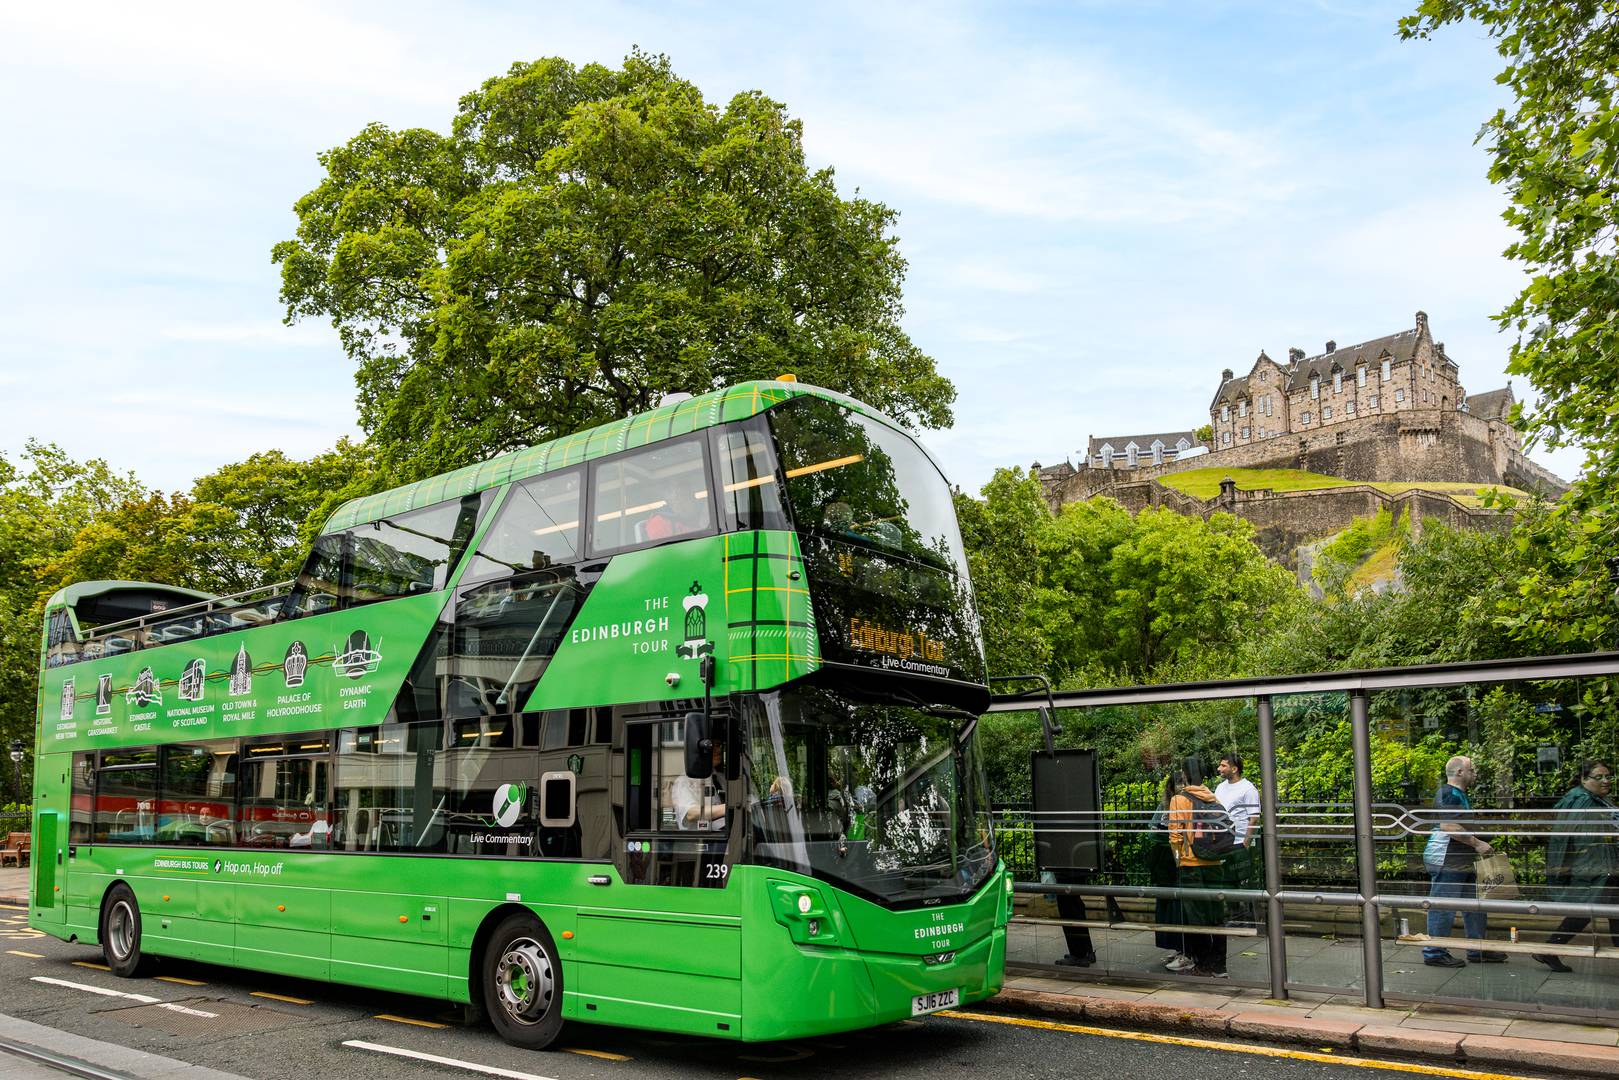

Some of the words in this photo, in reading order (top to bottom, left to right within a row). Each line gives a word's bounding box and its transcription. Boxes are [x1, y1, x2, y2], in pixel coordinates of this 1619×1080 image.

[645, 597, 669, 611] THE
[572, 617, 669, 643] EDINBURGH
[633, 640, 668, 654] TOUR
[882, 656, 899, 667] Live
[901, 659, 950, 677] Commentary
[339, 685, 372, 697] DYNAMIC
[277, 694, 301, 704] PALACE
[302, 693, 311, 701] OF
[343, 699, 367, 709] EARTH
[167, 708, 192, 717] NATIONAL
[192, 705, 215, 714] MUSEUM
[222, 702, 234, 711] OLD
[234, 700, 252, 709] TOWN
[252, 700, 257, 708] &
[266, 704, 323, 718] HOLYROODHOUSE
[129, 712, 157, 722] EDINBURGH
[172, 720, 180, 728] OF
[181, 717, 208, 726] SCOTLAND
[222, 714, 241, 722] ROYAL
[242, 711, 256, 720] MILE
[470, 834, 484, 843] Live
[485, 834, 533, 846] Commentary
[154, 859, 181, 868] EDINBURGH
[181, 860, 192, 869] BUS
[192, 861, 209, 870] TOURS
[224, 861, 239, 874] Hop
[240, 864, 252, 875] on,
[253, 862, 271, 876] Hop
[272, 863, 284, 875] off
[706, 863, 729, 879] 239
[931, 912, 945, 921] THE
[914, 922, 964, 939] EDINBURGH
[931, 939, 950, 949] TOUR
[917, 994, 937, 1011] SJ16
[938, 990, 954, 1007] ZZC
